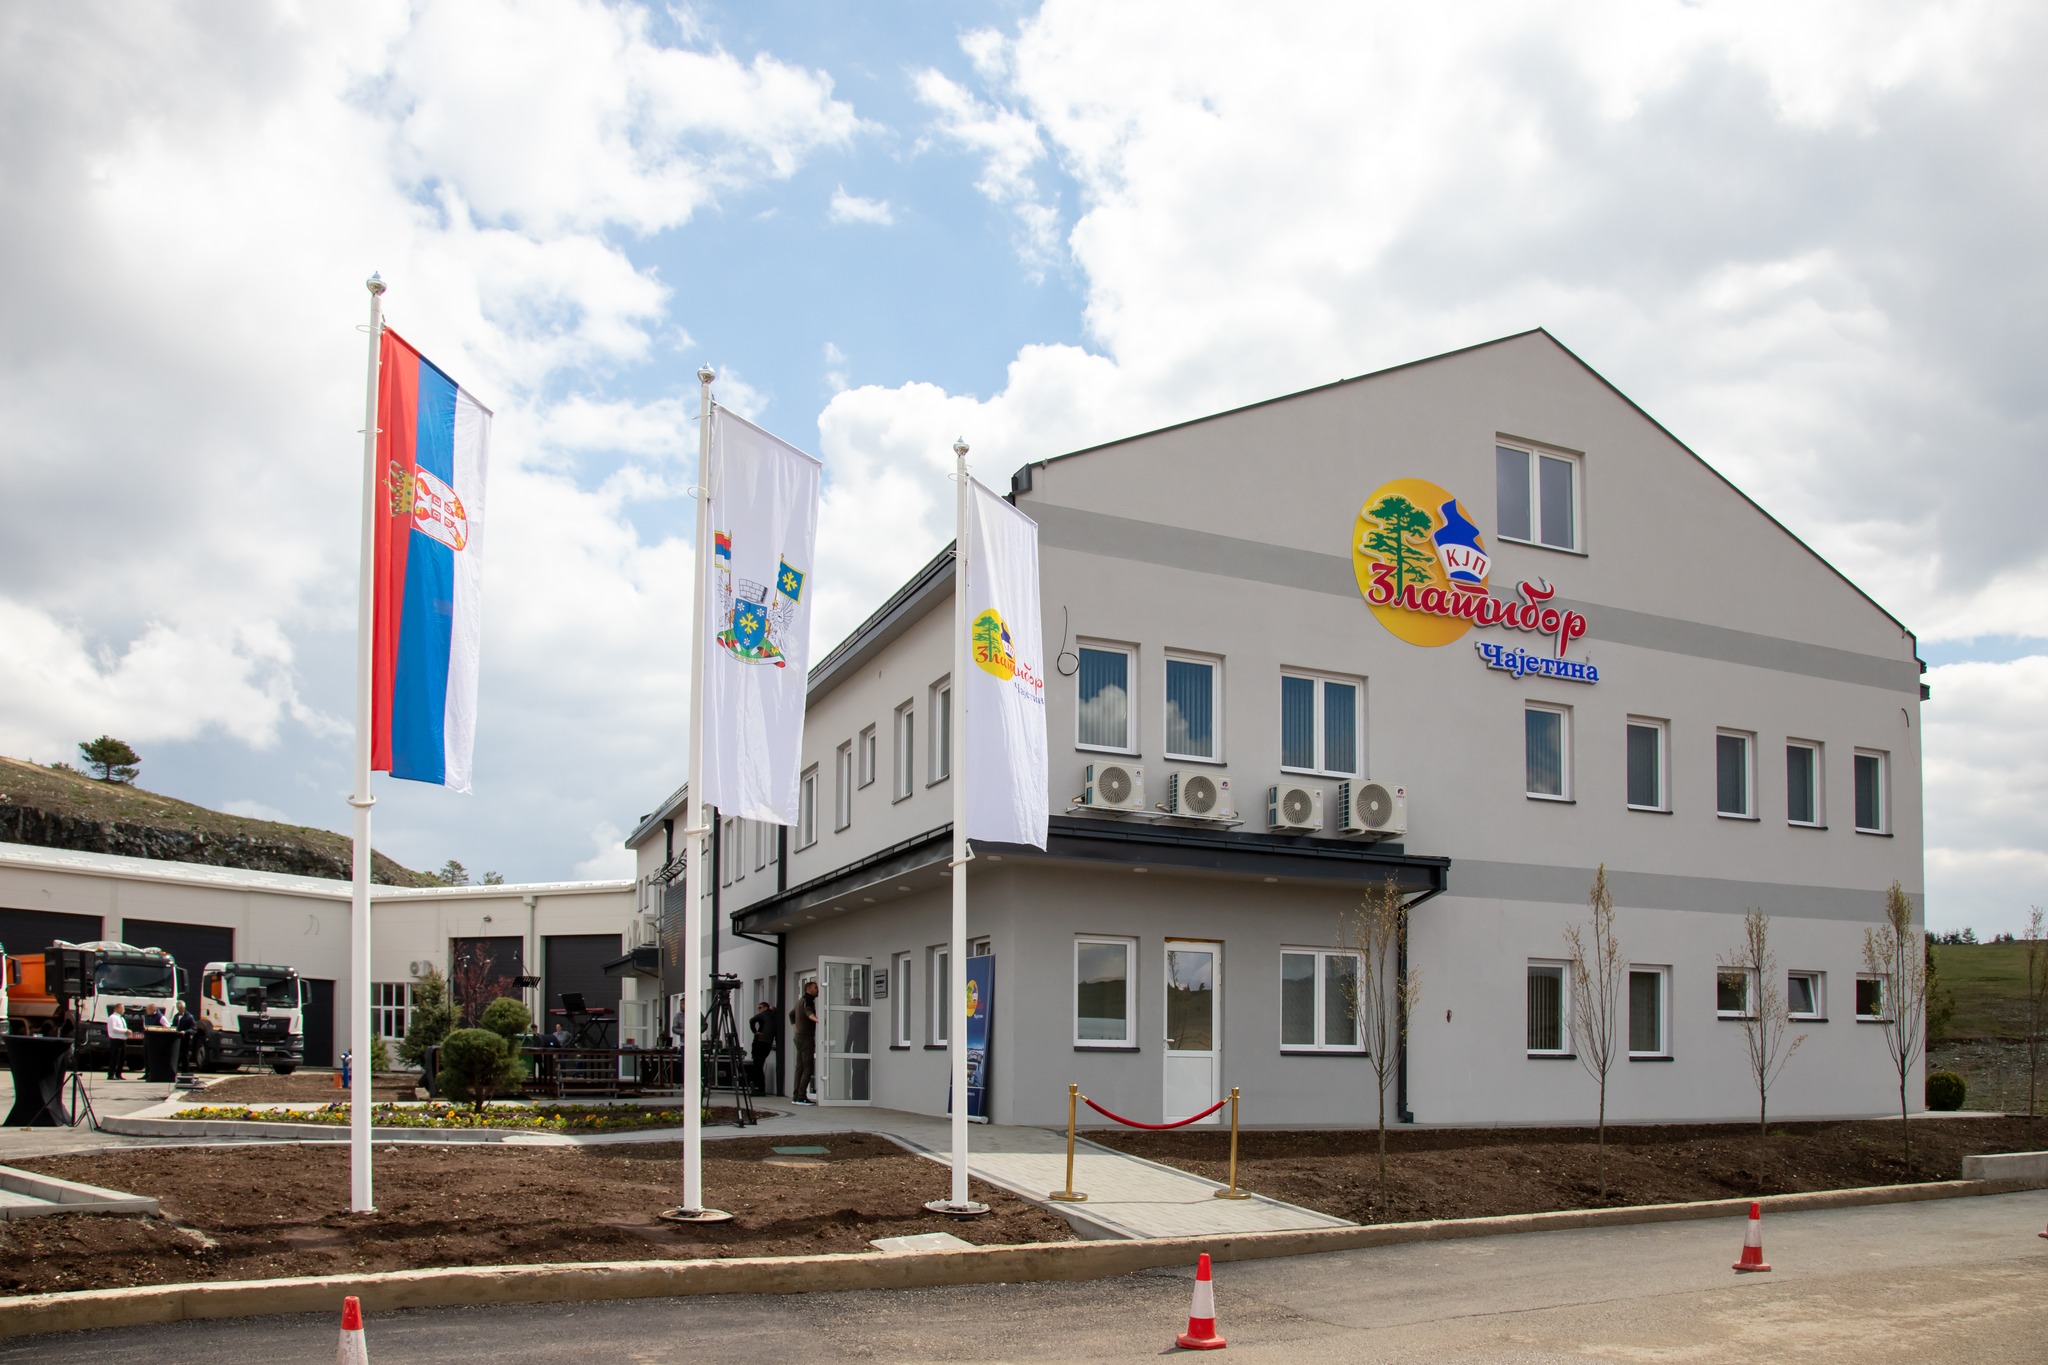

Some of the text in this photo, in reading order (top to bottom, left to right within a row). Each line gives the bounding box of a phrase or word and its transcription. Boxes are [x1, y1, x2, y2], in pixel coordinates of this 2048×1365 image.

[1445, 548, 1487, 576] КЈП
[1367, 561, 1587, 658] Златибор
[1480, 642, 1600, 682] Чајетина
